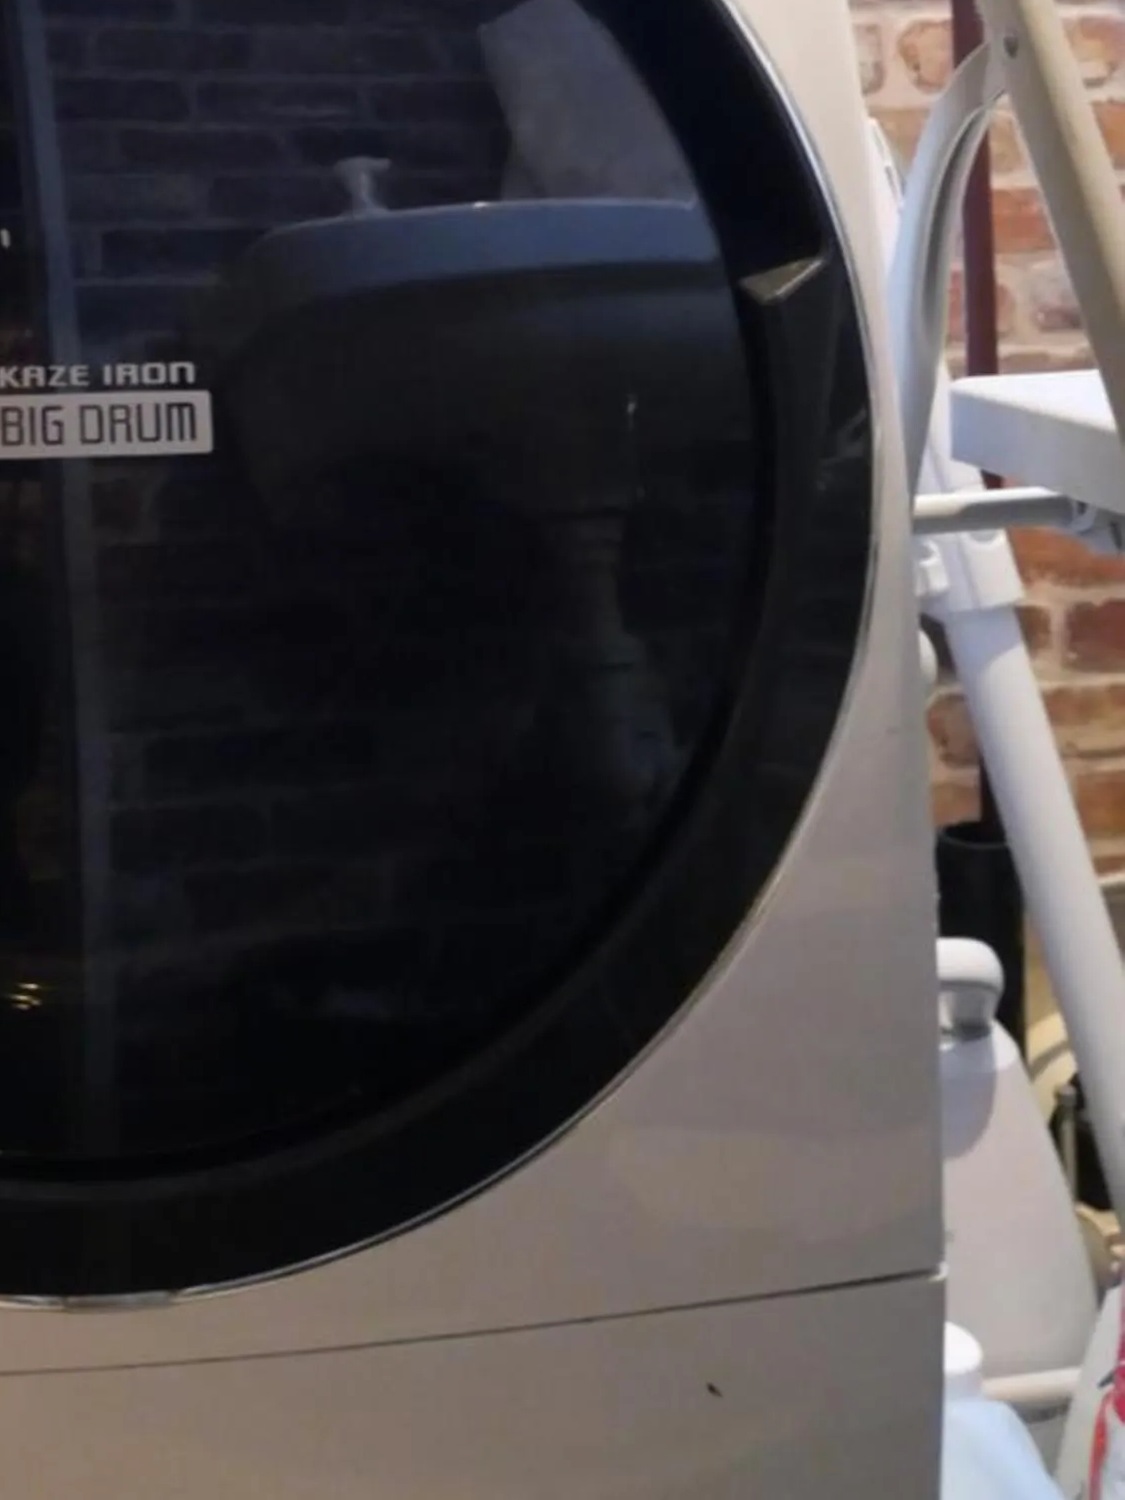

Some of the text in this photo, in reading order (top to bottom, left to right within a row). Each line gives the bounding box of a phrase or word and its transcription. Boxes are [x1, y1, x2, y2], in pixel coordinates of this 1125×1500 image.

[102, 361, 196, 386] IRON
[0, 401, 198, 448] BIG DRUM
